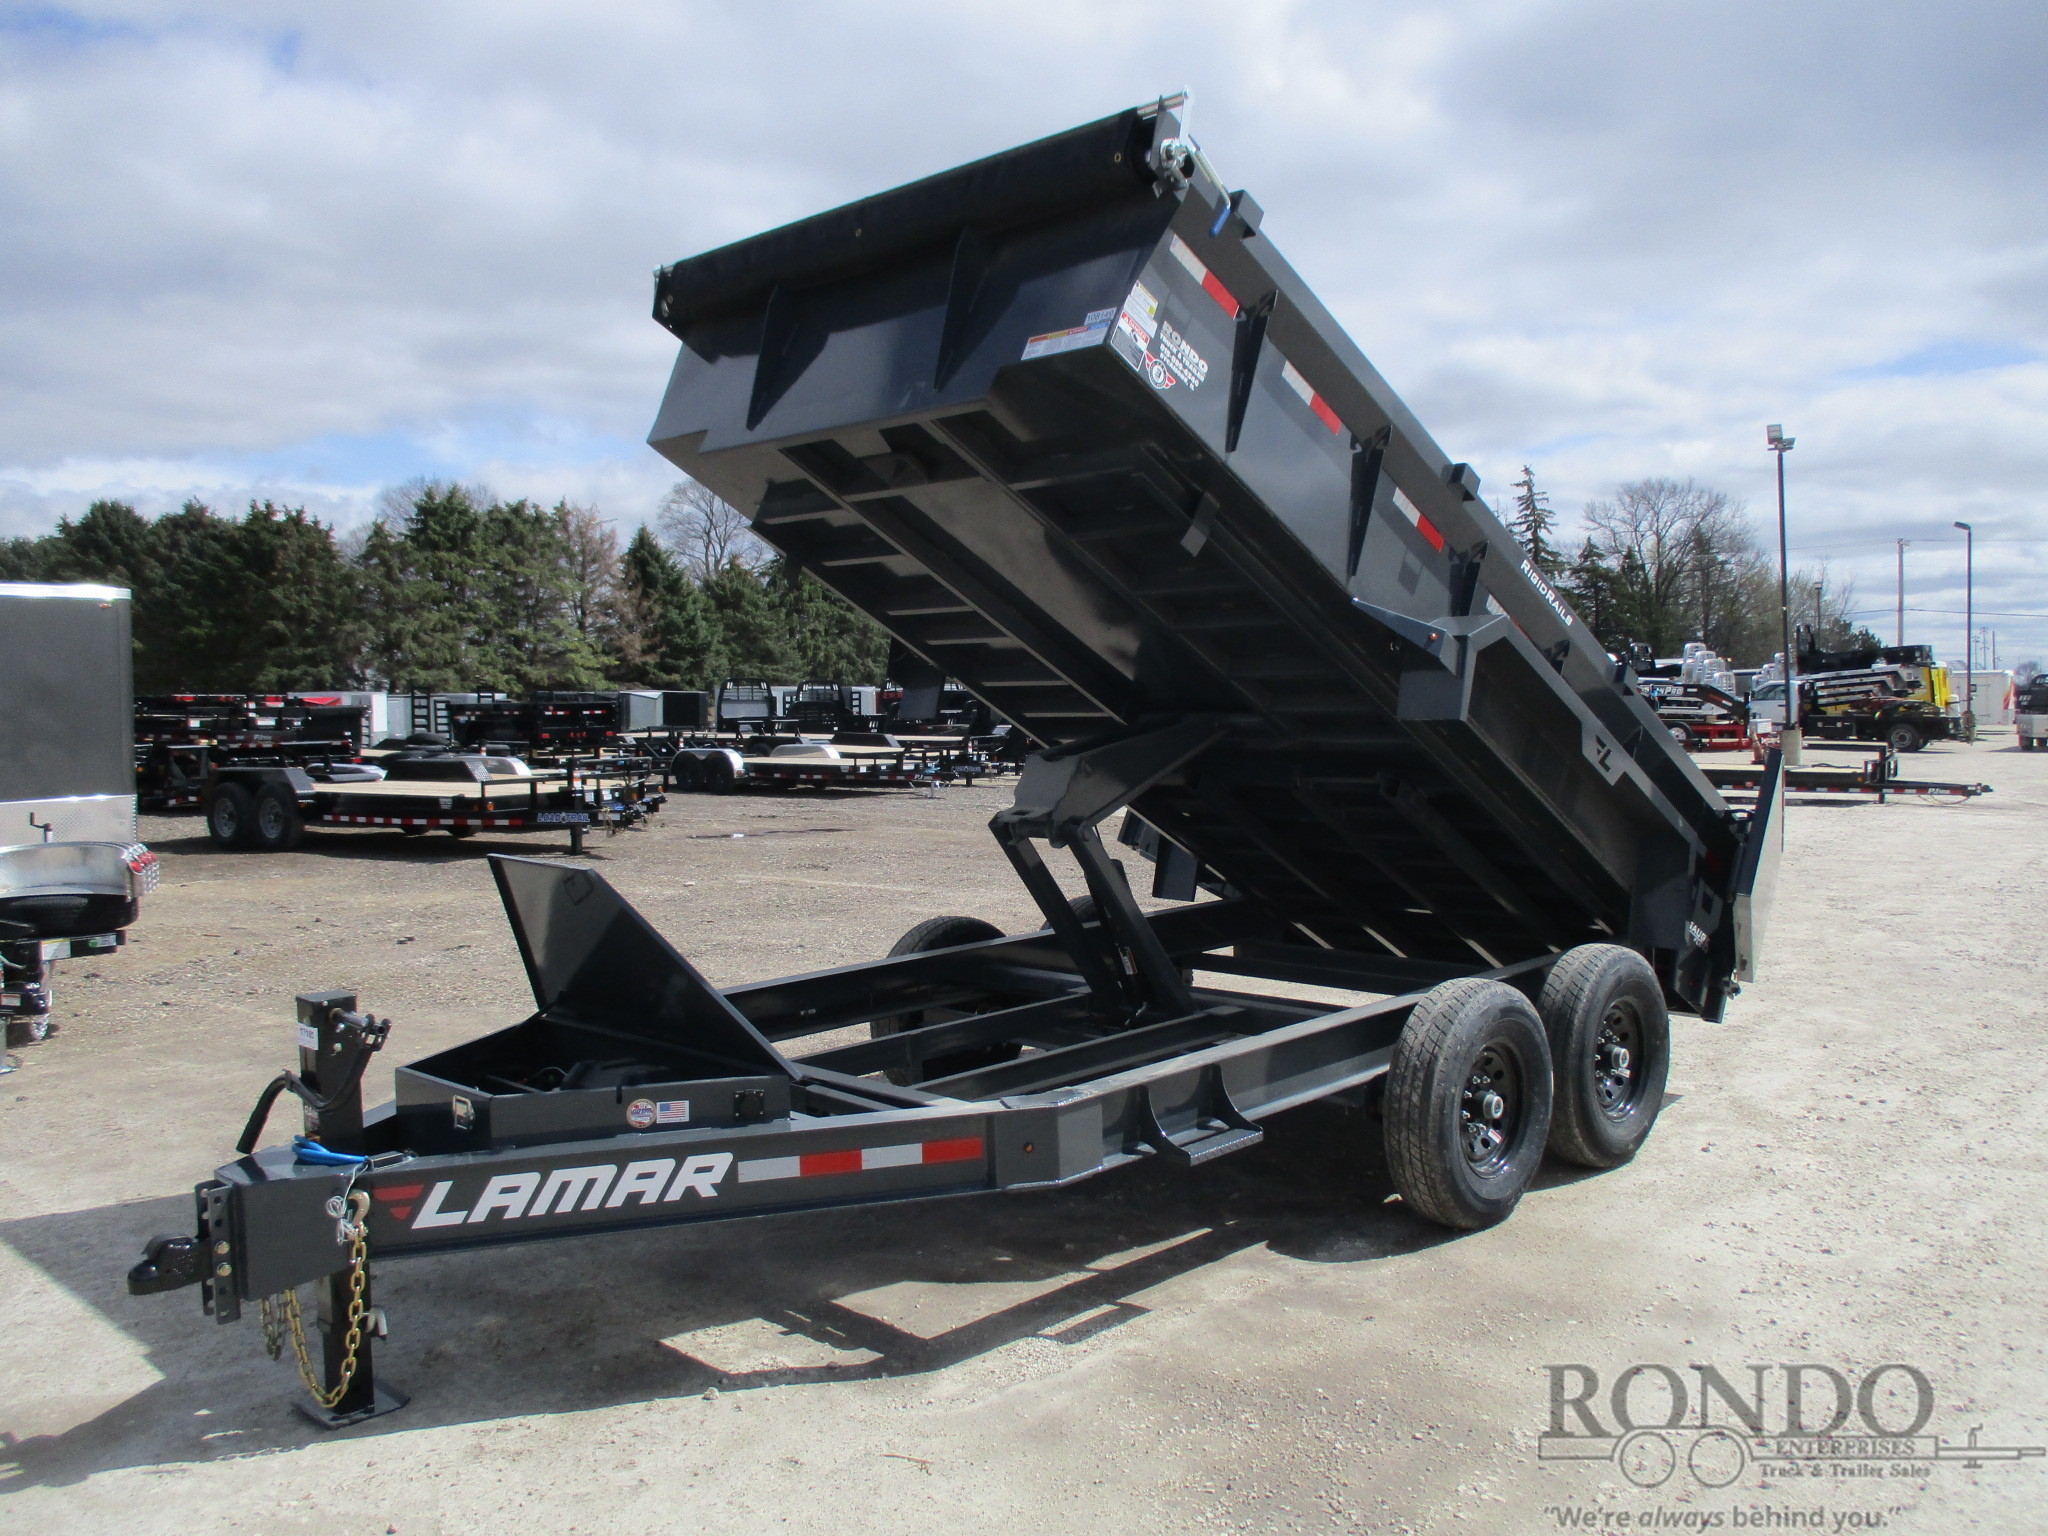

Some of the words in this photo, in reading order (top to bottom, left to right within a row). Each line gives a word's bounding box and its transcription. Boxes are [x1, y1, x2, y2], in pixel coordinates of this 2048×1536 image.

[1129, 319, 1147, 342] DANGER
[1162, 320, 1209, 374] RONDO
[1520, 559, 1573, 626] RIGIDRAILS
[537, 812, 562, 823] LOAD
[565, 812, 590, 823] TRAIL
[411, 1152, 735, 1231] LAMAR
